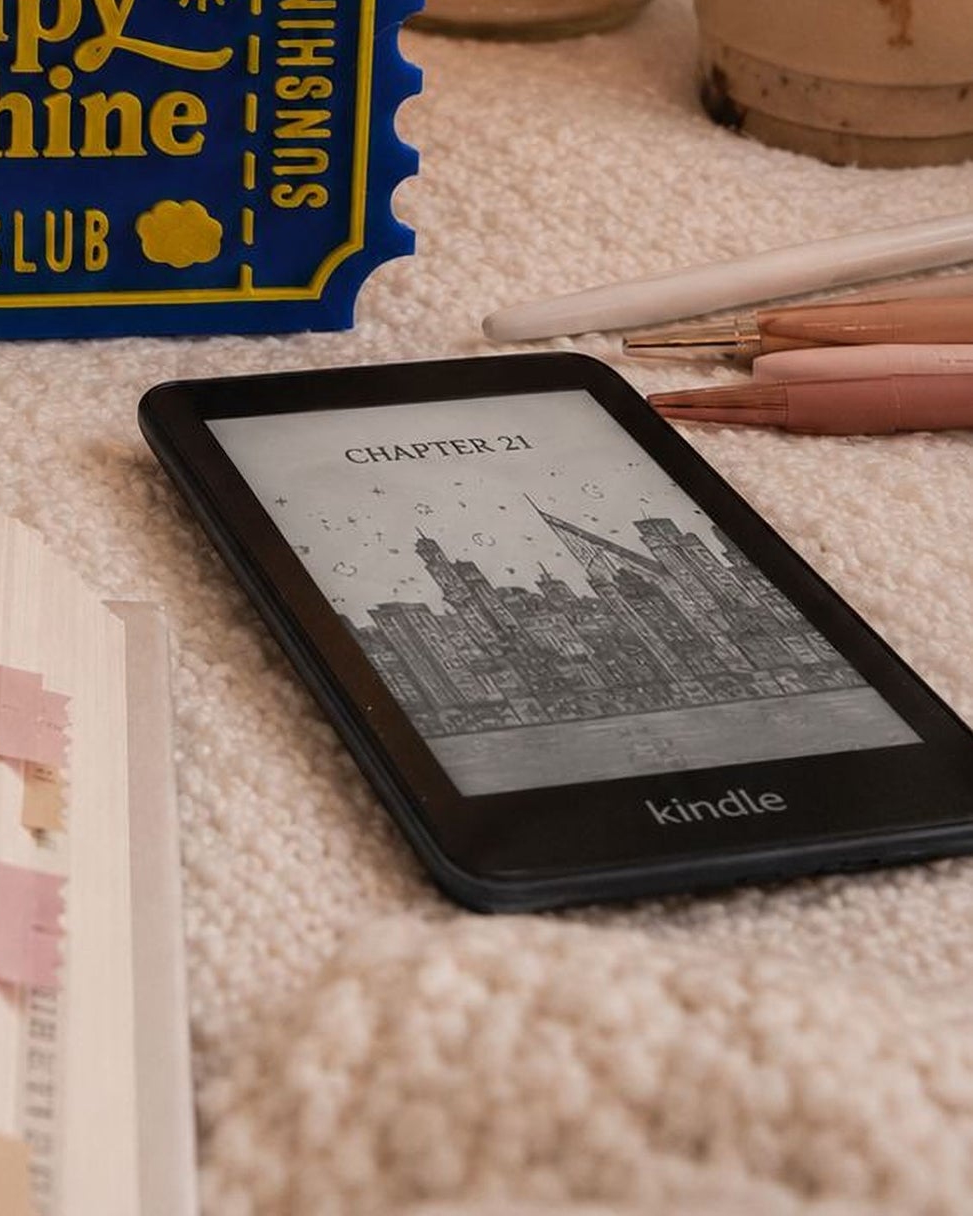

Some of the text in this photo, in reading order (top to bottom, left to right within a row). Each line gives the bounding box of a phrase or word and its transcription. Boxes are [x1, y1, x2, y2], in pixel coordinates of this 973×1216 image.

[344, 434, 534, 464] CHAPTER 21
[645, 787, 788, 825] kindle
